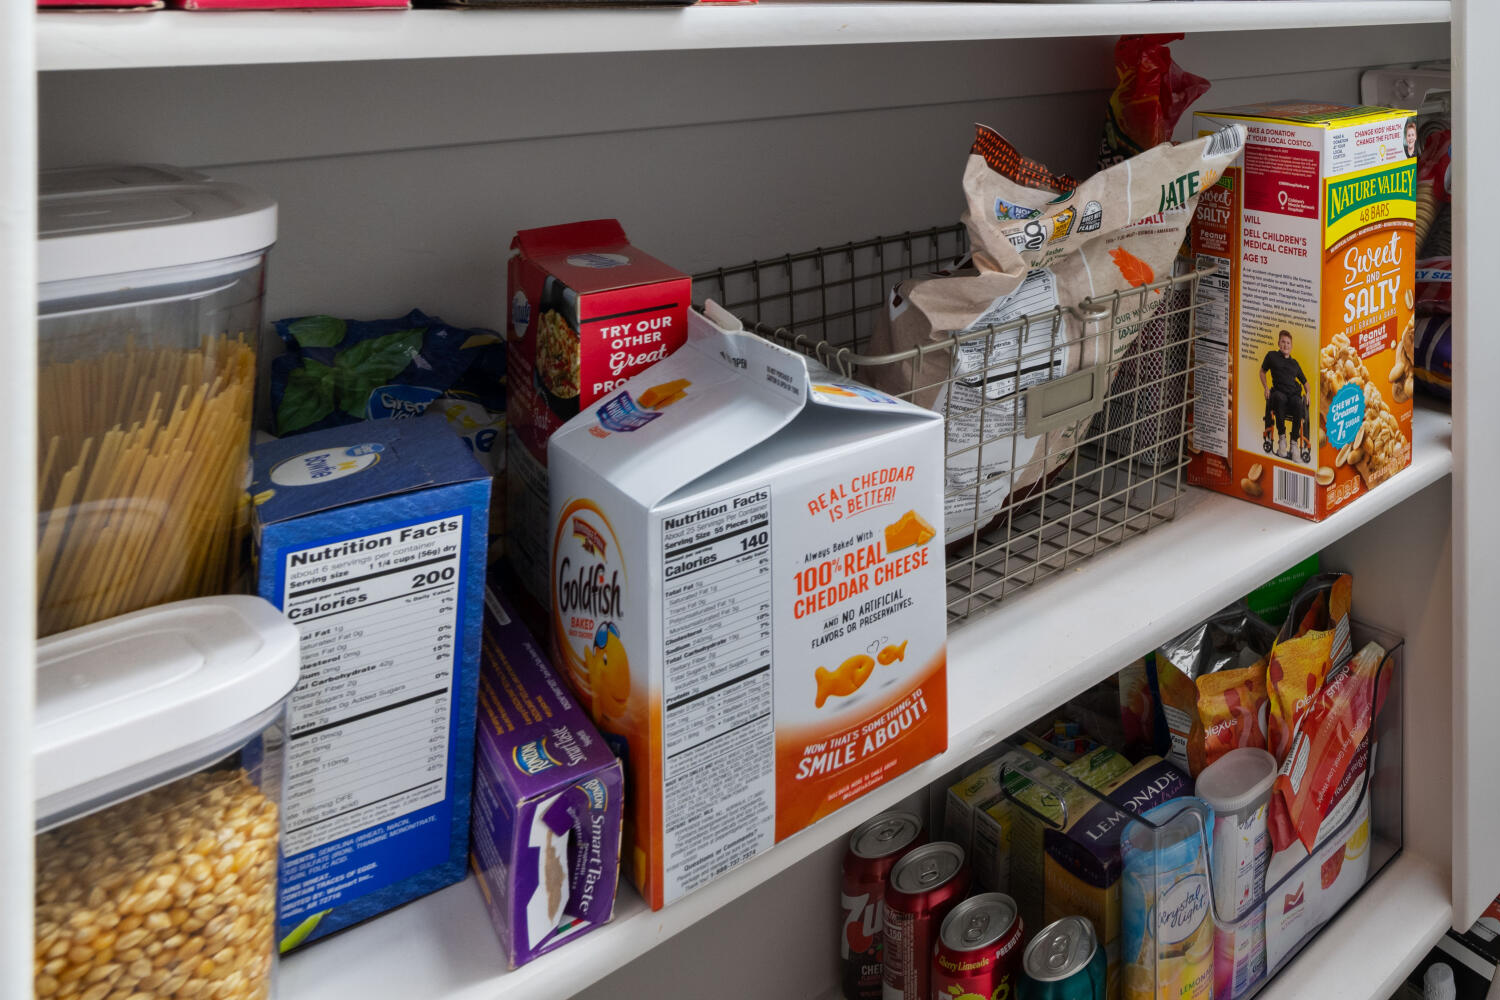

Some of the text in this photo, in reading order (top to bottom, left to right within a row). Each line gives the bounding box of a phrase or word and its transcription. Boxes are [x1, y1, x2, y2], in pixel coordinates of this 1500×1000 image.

[1330, 168, 1415, 220] NATURE VALLEY
[1359, 203, 1390, 223] 48 BARS
[1344, 231, 1402, 285] Sweet
[1366, 270, 1380, 284] AND
[1343, 275, 1400, 324] SALTY
[600, 316, 673, 340] TRY OUR
[611, 331, 662, 350] OTHER
[1359, 324, 1386, 344] Peanut
[609, 342, 669, 377] Great
[808, 465, 916, 516] REAL CHEDDAR
[828, 486, 898, 523] IS BETTER!
[290, 519, 459, 568] Nutrition Facts
[287, 566, 455, 620] Calories 200
[559, 556, 622, 618] Goldfish
[793, 541, 886, 596] 100% REAL
[793, 546, 929, 620] CHEDDAR CHEESE
[570, 616, 595, 631] BAKED
[823, 588, 904, 631] AND NO ARTIFICIAL
[795, 696, 929, 781] SMILE ABOUT!
[803, 687, 923, 757] NOW THAT'S SOMETHING TO
[579, 814, 605, 914] Smart Taste
[958, 957, 990, 972] Limeade
